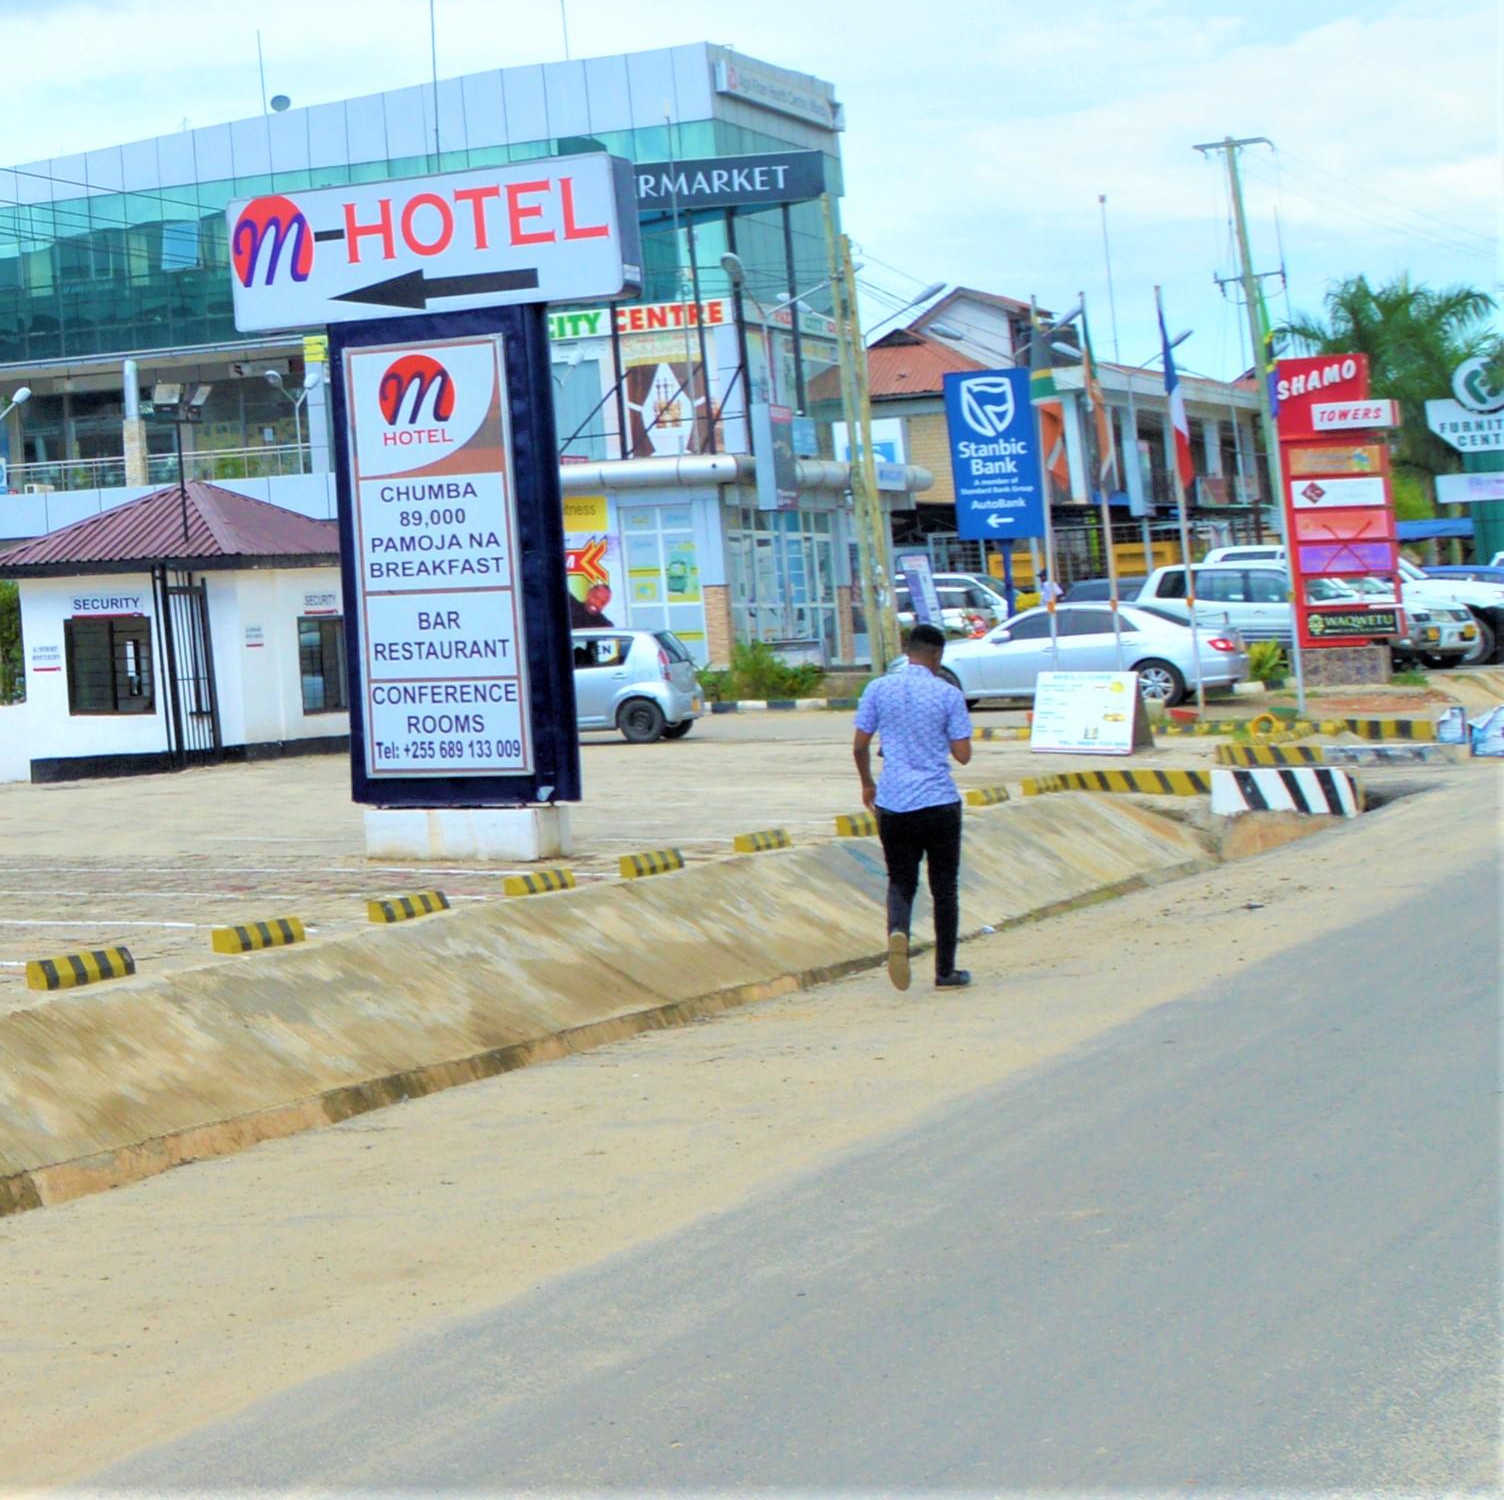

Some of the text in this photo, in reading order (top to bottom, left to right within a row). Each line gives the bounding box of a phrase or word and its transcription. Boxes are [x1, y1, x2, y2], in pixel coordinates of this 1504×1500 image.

[633, 165, 789, 199] RMARKET
[616, 301, 723, 332] CENTRE
[1277, 359, 1356, 400] SHAMO
[1319, 407, 1382, 423] TOWERS
[383, 428, 454, 446] HOTEL
[1457, 433, 1500, 447] CENT
[958, 438, 1028, 458] Stanbic
[970, 457, 1018, 475] Bank
[380, 482, 478, 503] CHUMBA
[971, 497, 1027, 510] AutoBank
[399, 508, 466, 528] 89,000
[371, 532, 501, 553] PAMOJA NA
[370, 556, 504, 578] BREAKFAST
[73, 596, 140, 610] SECURITY
[304, 594, 336, 606] SECURITY
[418, 611, 461, 630] BAR
[374, 639, 510, 661] RESTAURANT
[372, 683, 518, 705] CONFERENCE
[407, 714, 485, 734] ROOMS
[376, 739, 521, 759] Tel: +255 689 133 009
